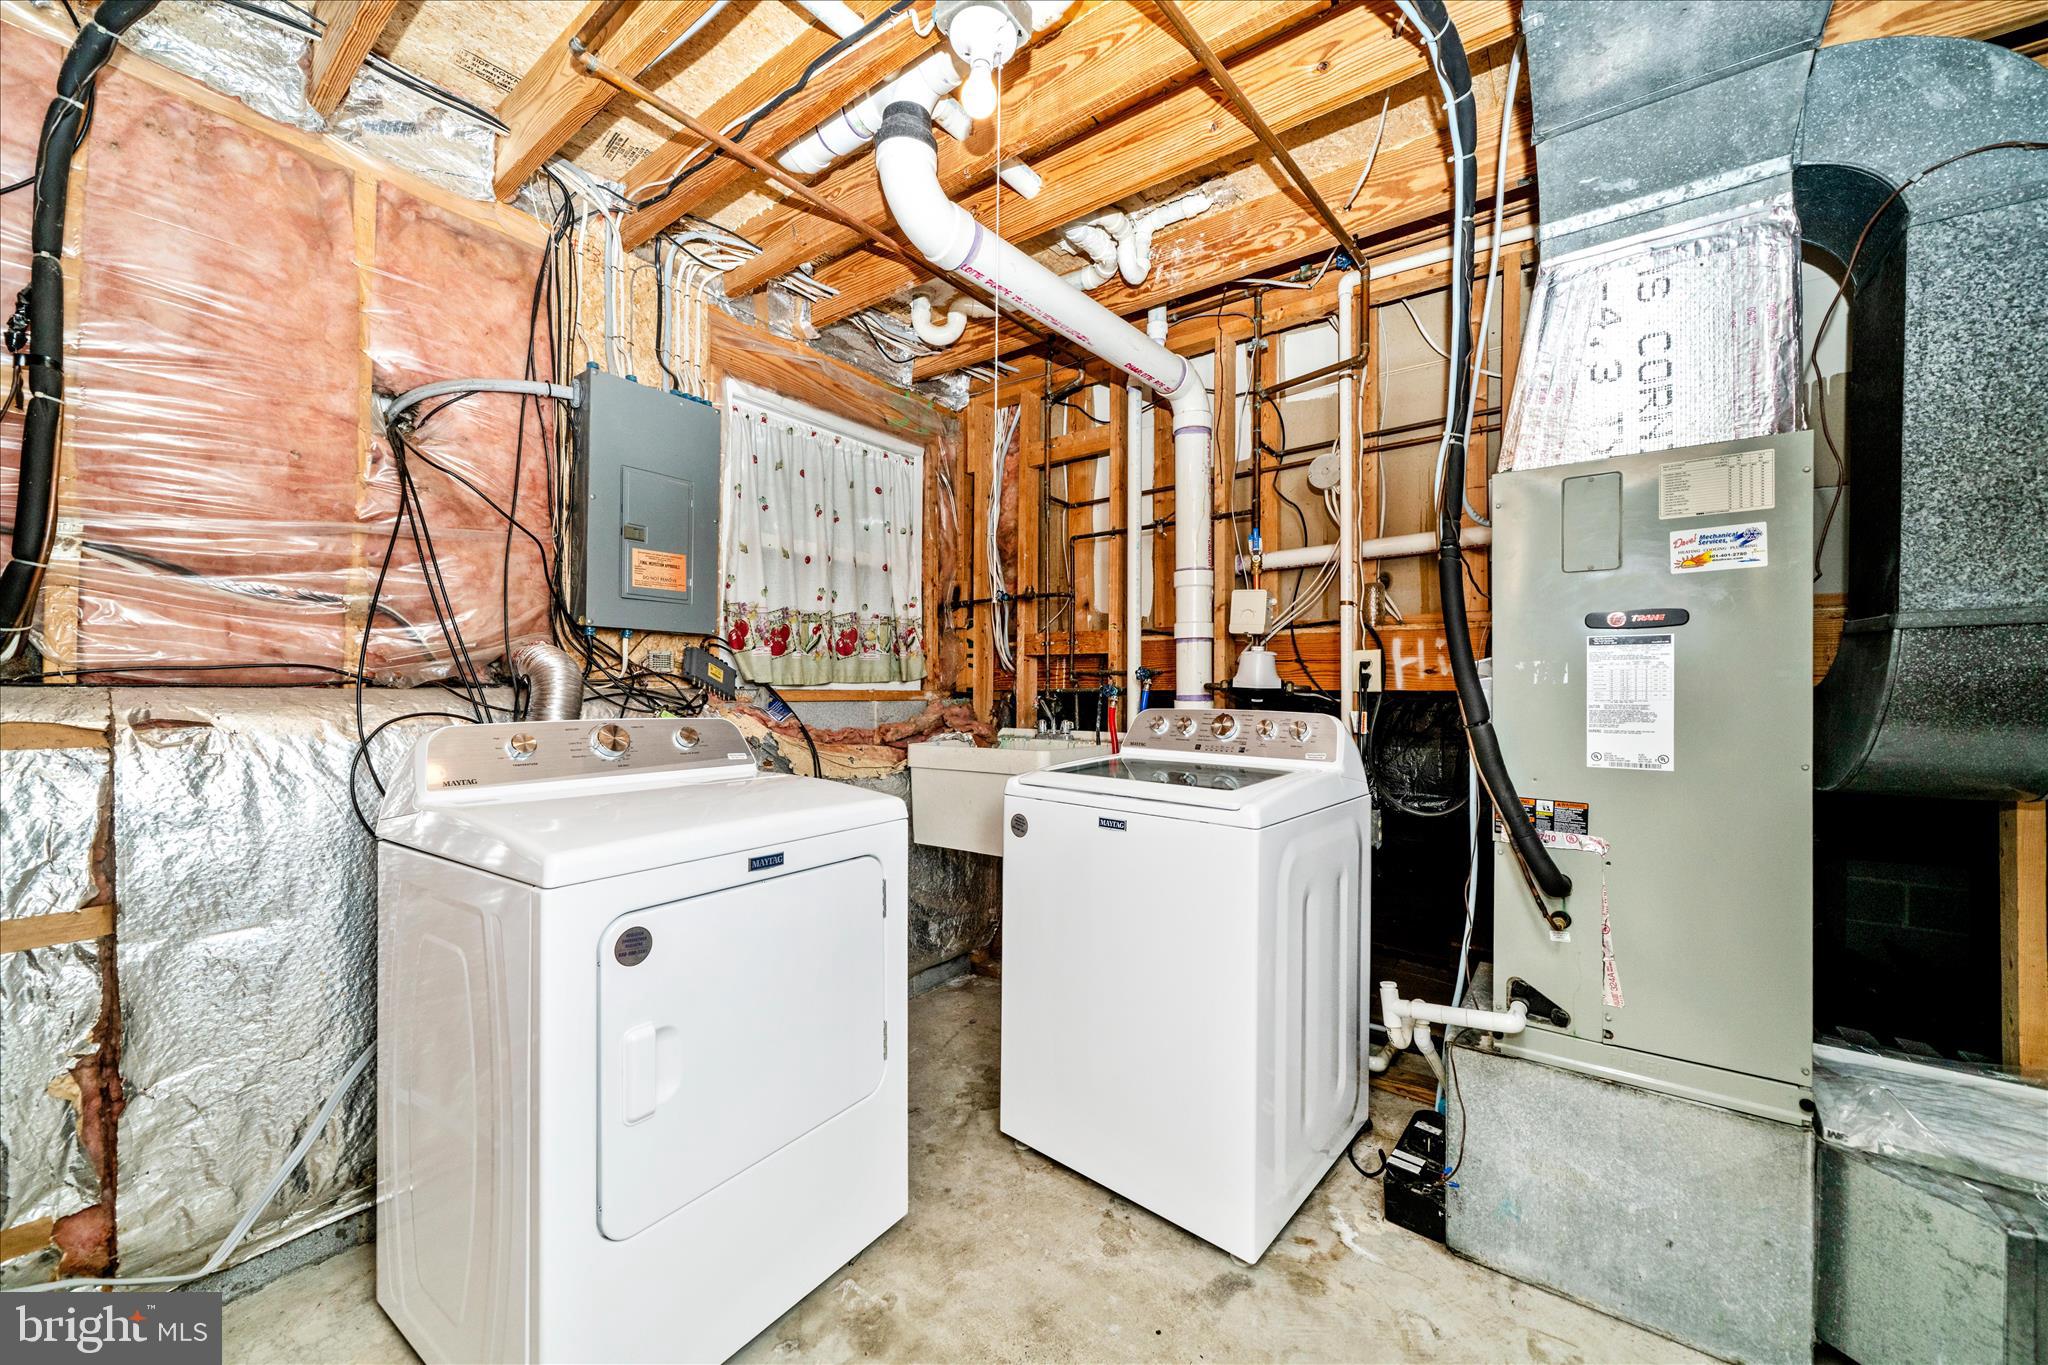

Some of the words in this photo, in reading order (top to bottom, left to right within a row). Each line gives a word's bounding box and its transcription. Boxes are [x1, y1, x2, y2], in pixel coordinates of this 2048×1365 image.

[1637, 330, 1675, 452] CORN
[1631, 613, 1666, 623] TRANE
[442, 778, 478, 788] MAYTAG
[1099, 818, 1125, 829] MAYTAG
[751, 855, 783, 869] MAYTAG
